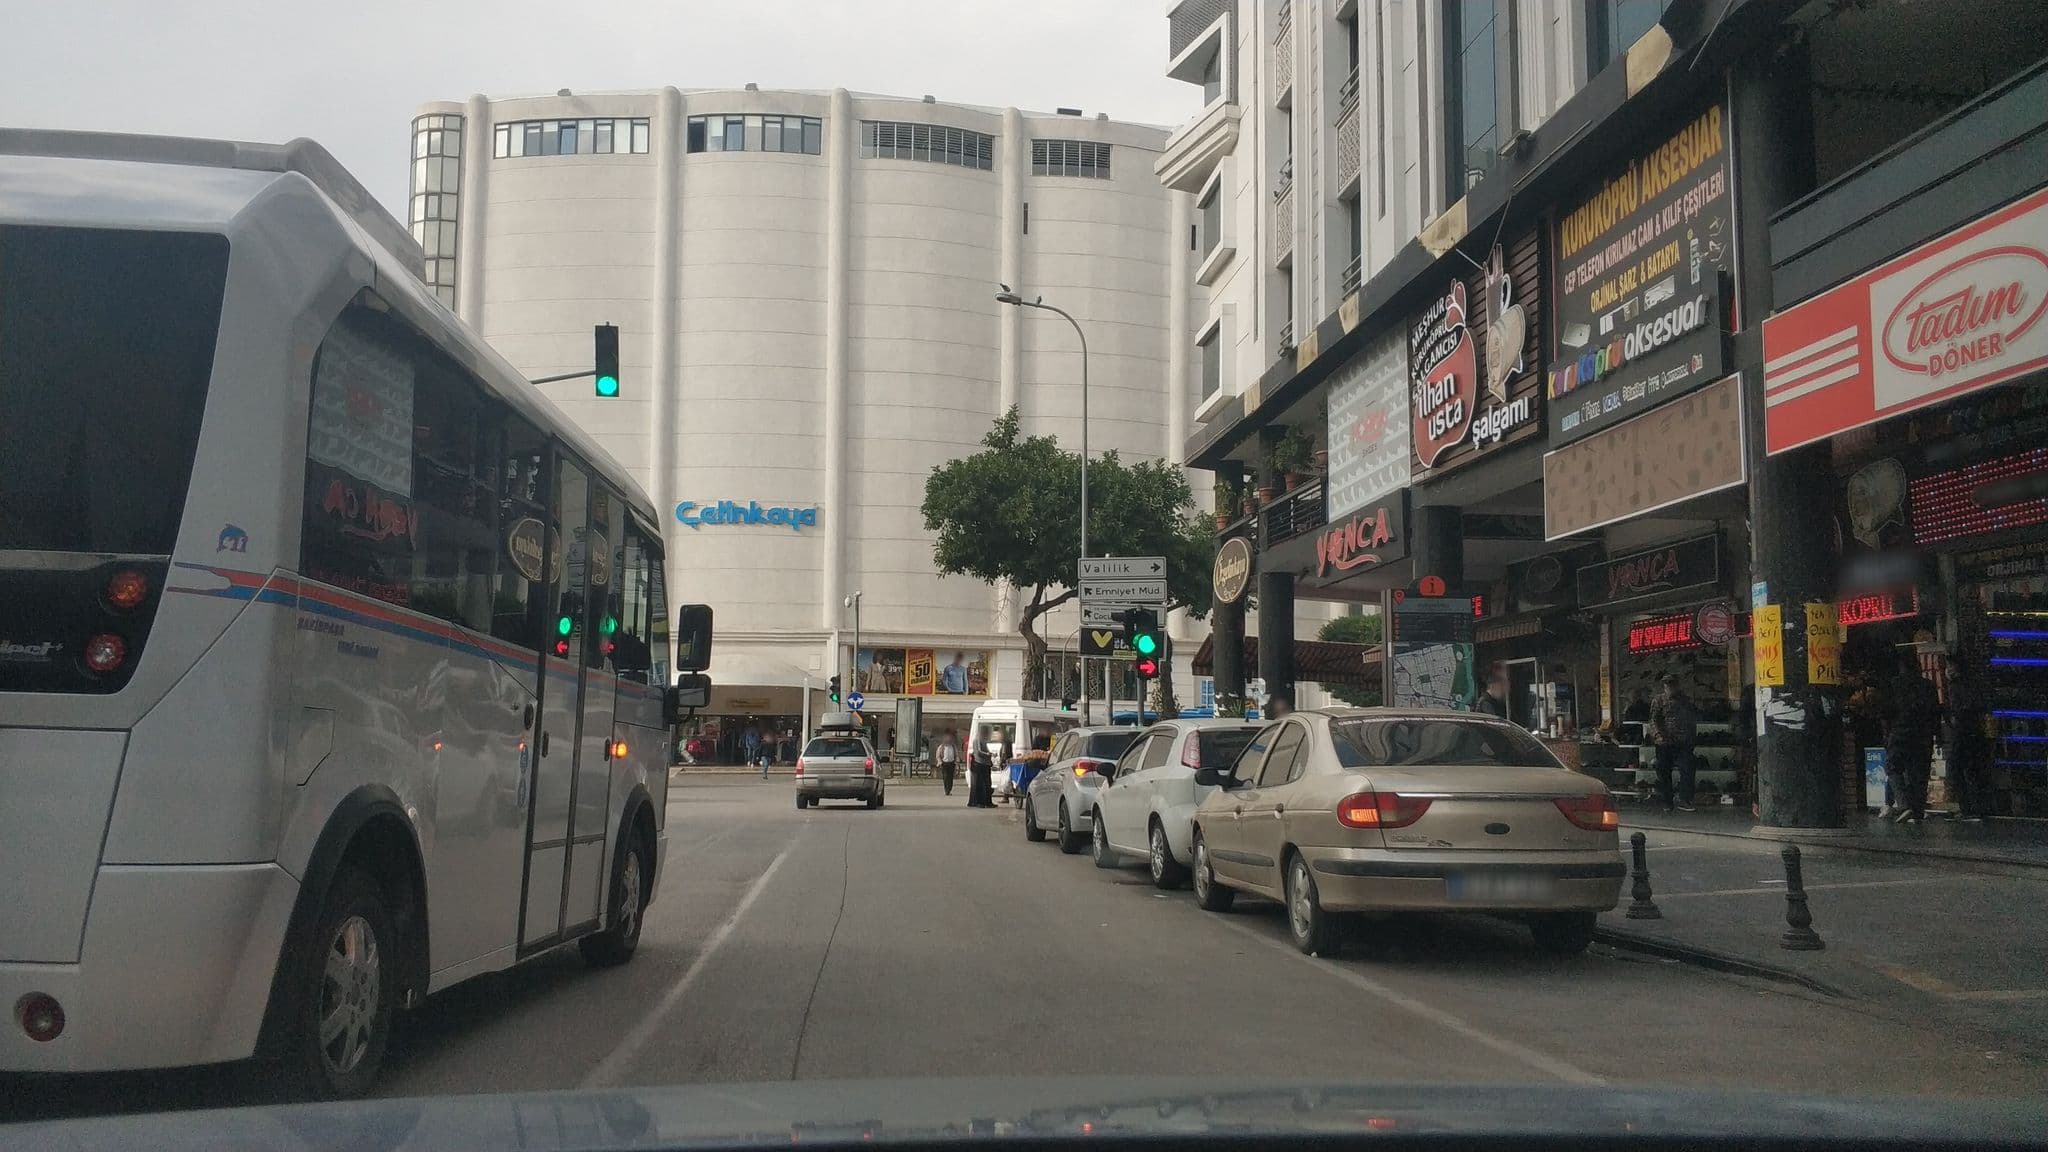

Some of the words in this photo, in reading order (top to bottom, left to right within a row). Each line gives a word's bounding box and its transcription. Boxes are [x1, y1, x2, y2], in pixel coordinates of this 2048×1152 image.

[1561, 158, 1638, 260] KURUKÖPRÜ
[1641, 104, 1723, 205] AKSESUAR
[1564, 269, 1576, 295] CEP
[1576, 250, 1605, 288] TELEFON
[1605, 228, 1638, 271] KIRILMAZ
[1637, 216, 1654, 249] CAM
[1655, 212, 1661, 238] &
[1662, 197, 1683, 233] KILIF
[1682, 163, 1725, 224] ÇEŞİTLERİ
[1640, 260, 1646, 285] &
[1647, 239, 1681, 280] BATARYA
[1411, 296, 1446, 353] MEŞHUR
[1624, 294, 1706, 361] aksesuar
[1905, 281, 2022, 354] tadım
[1928, 332, 2003, 377] DÖNER
[1428, 397, 1463, 442] usta
[1083, 563, 1130, 574] Valilik
[1095, 587, 1136, 597] Emniyet
